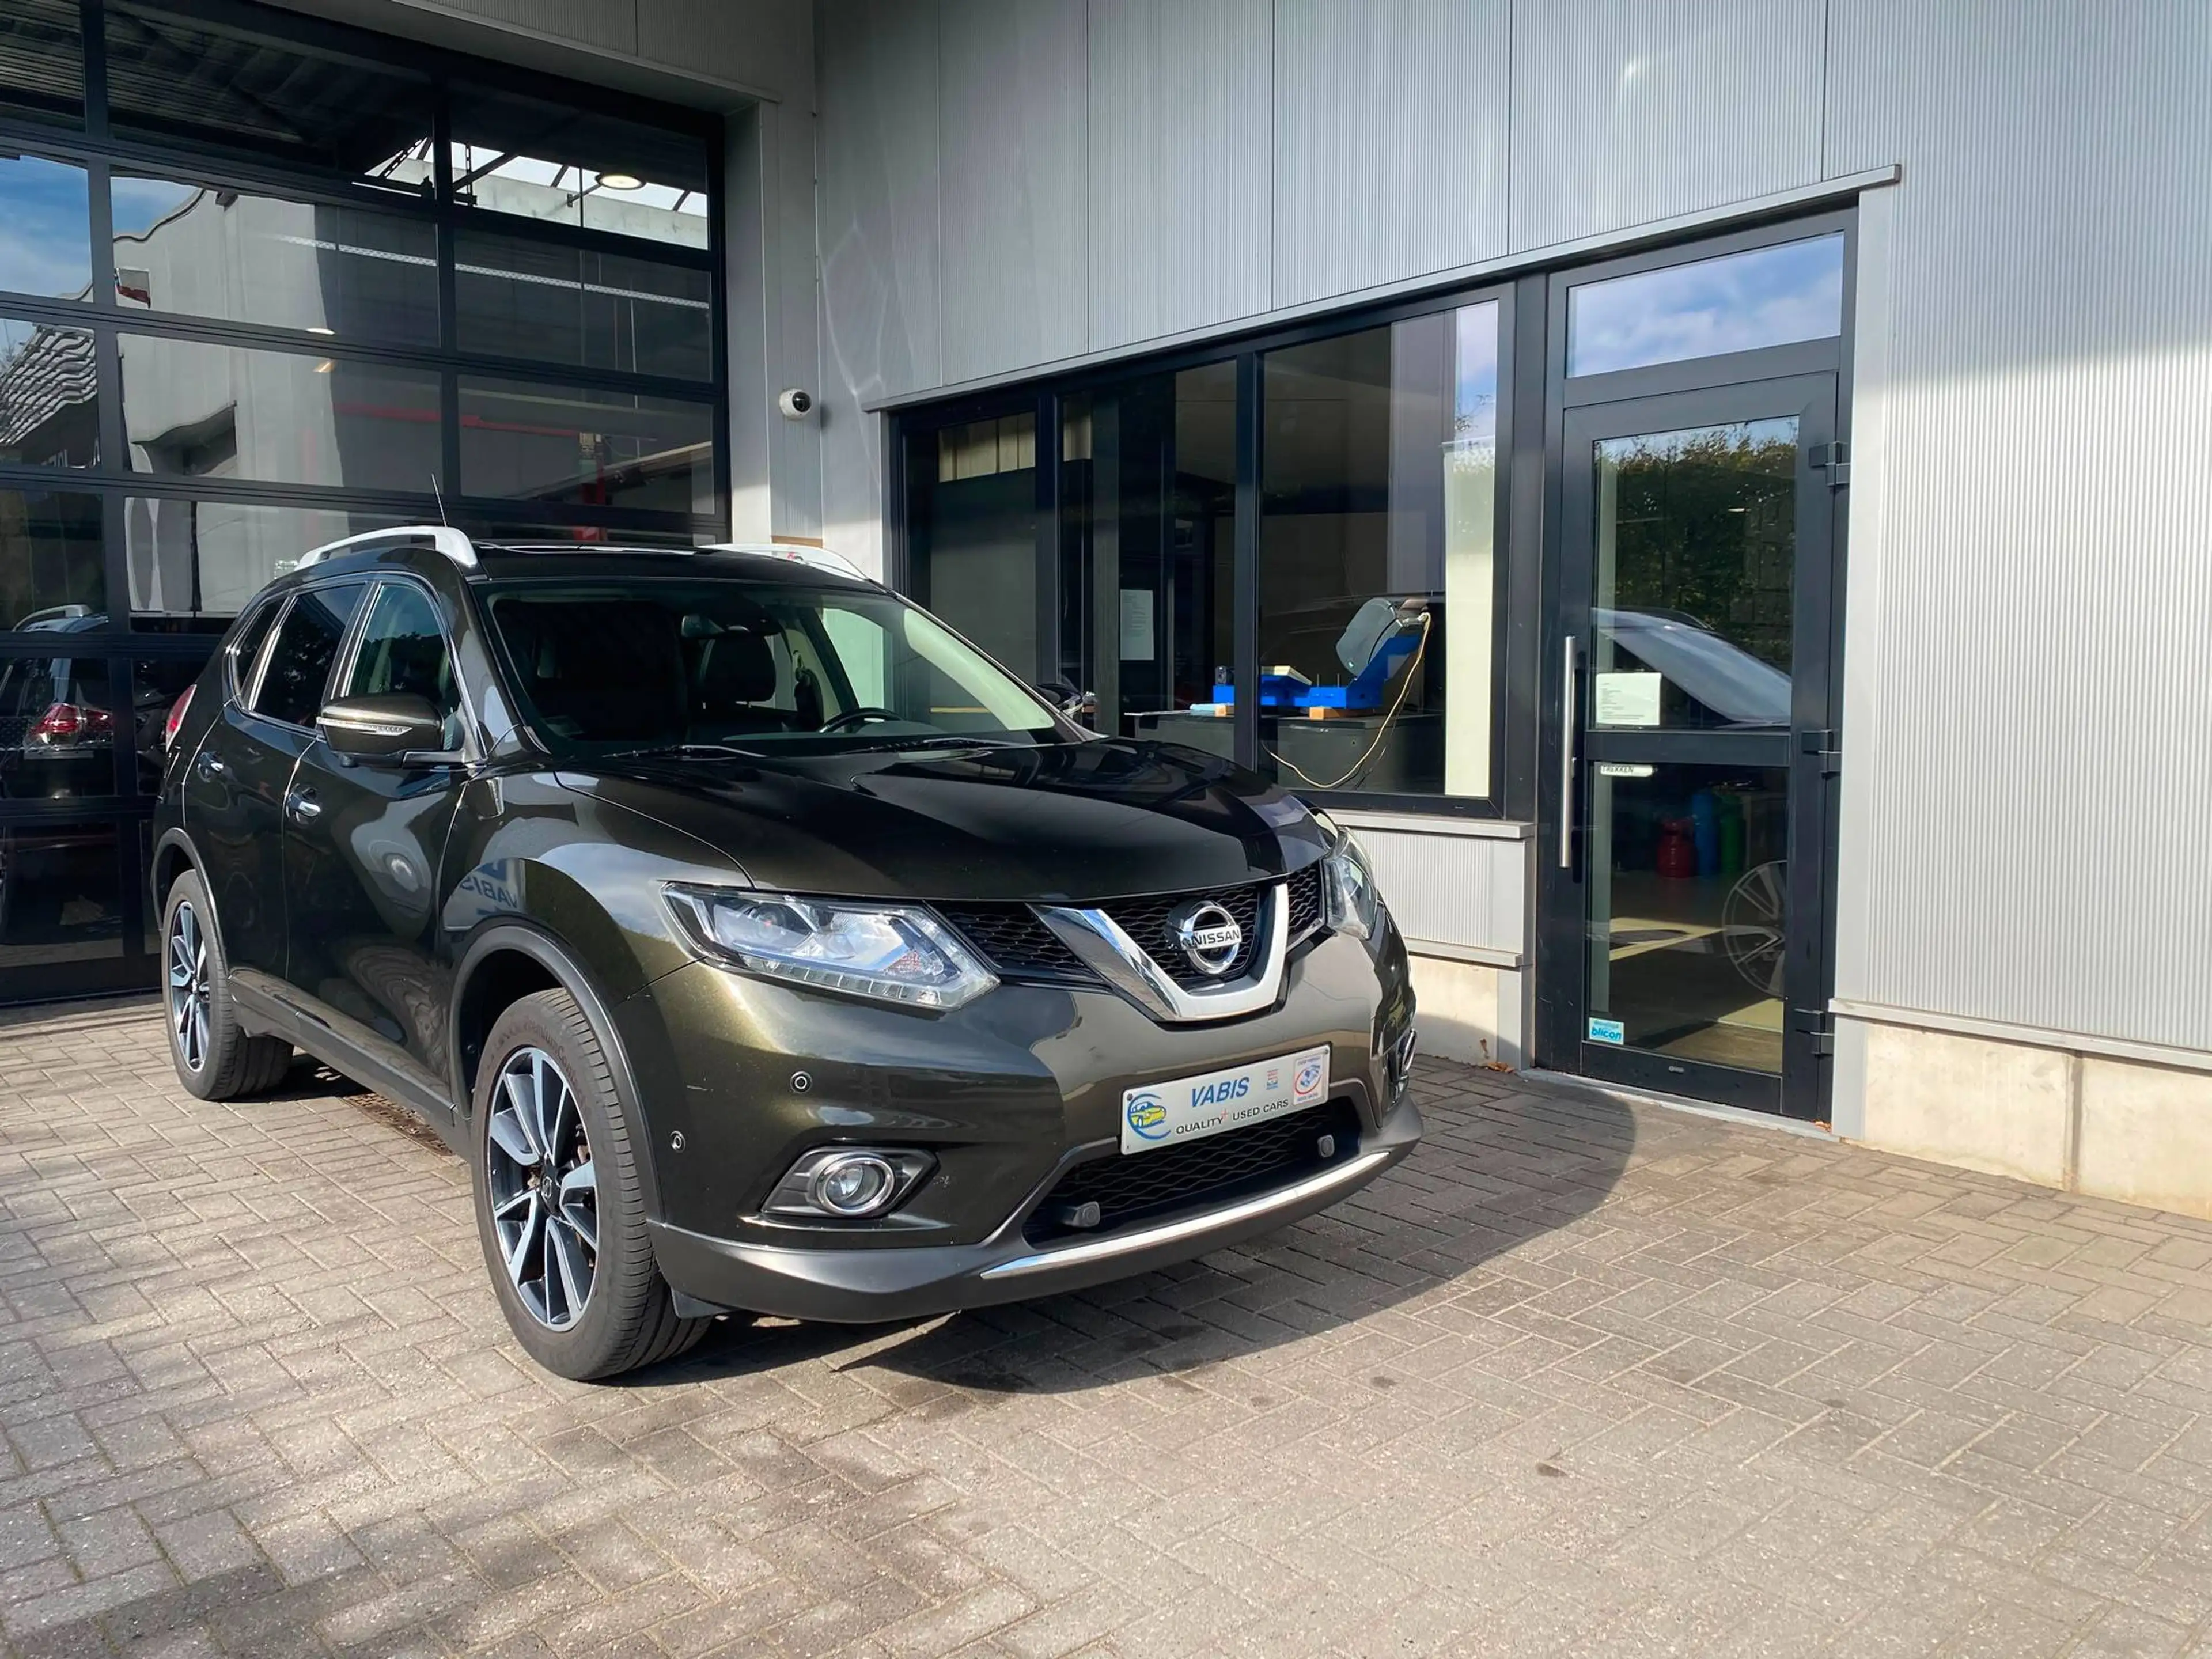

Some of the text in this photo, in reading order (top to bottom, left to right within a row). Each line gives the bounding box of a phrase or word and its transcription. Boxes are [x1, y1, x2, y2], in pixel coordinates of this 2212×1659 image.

[1192, 929, 1240, 945] NISSAN
[1191, 1076, 1250, 1108] VABIS
[1233, 1107, 1260, 1121] USED
[1263, 1099, 1289, 1113] CARS
